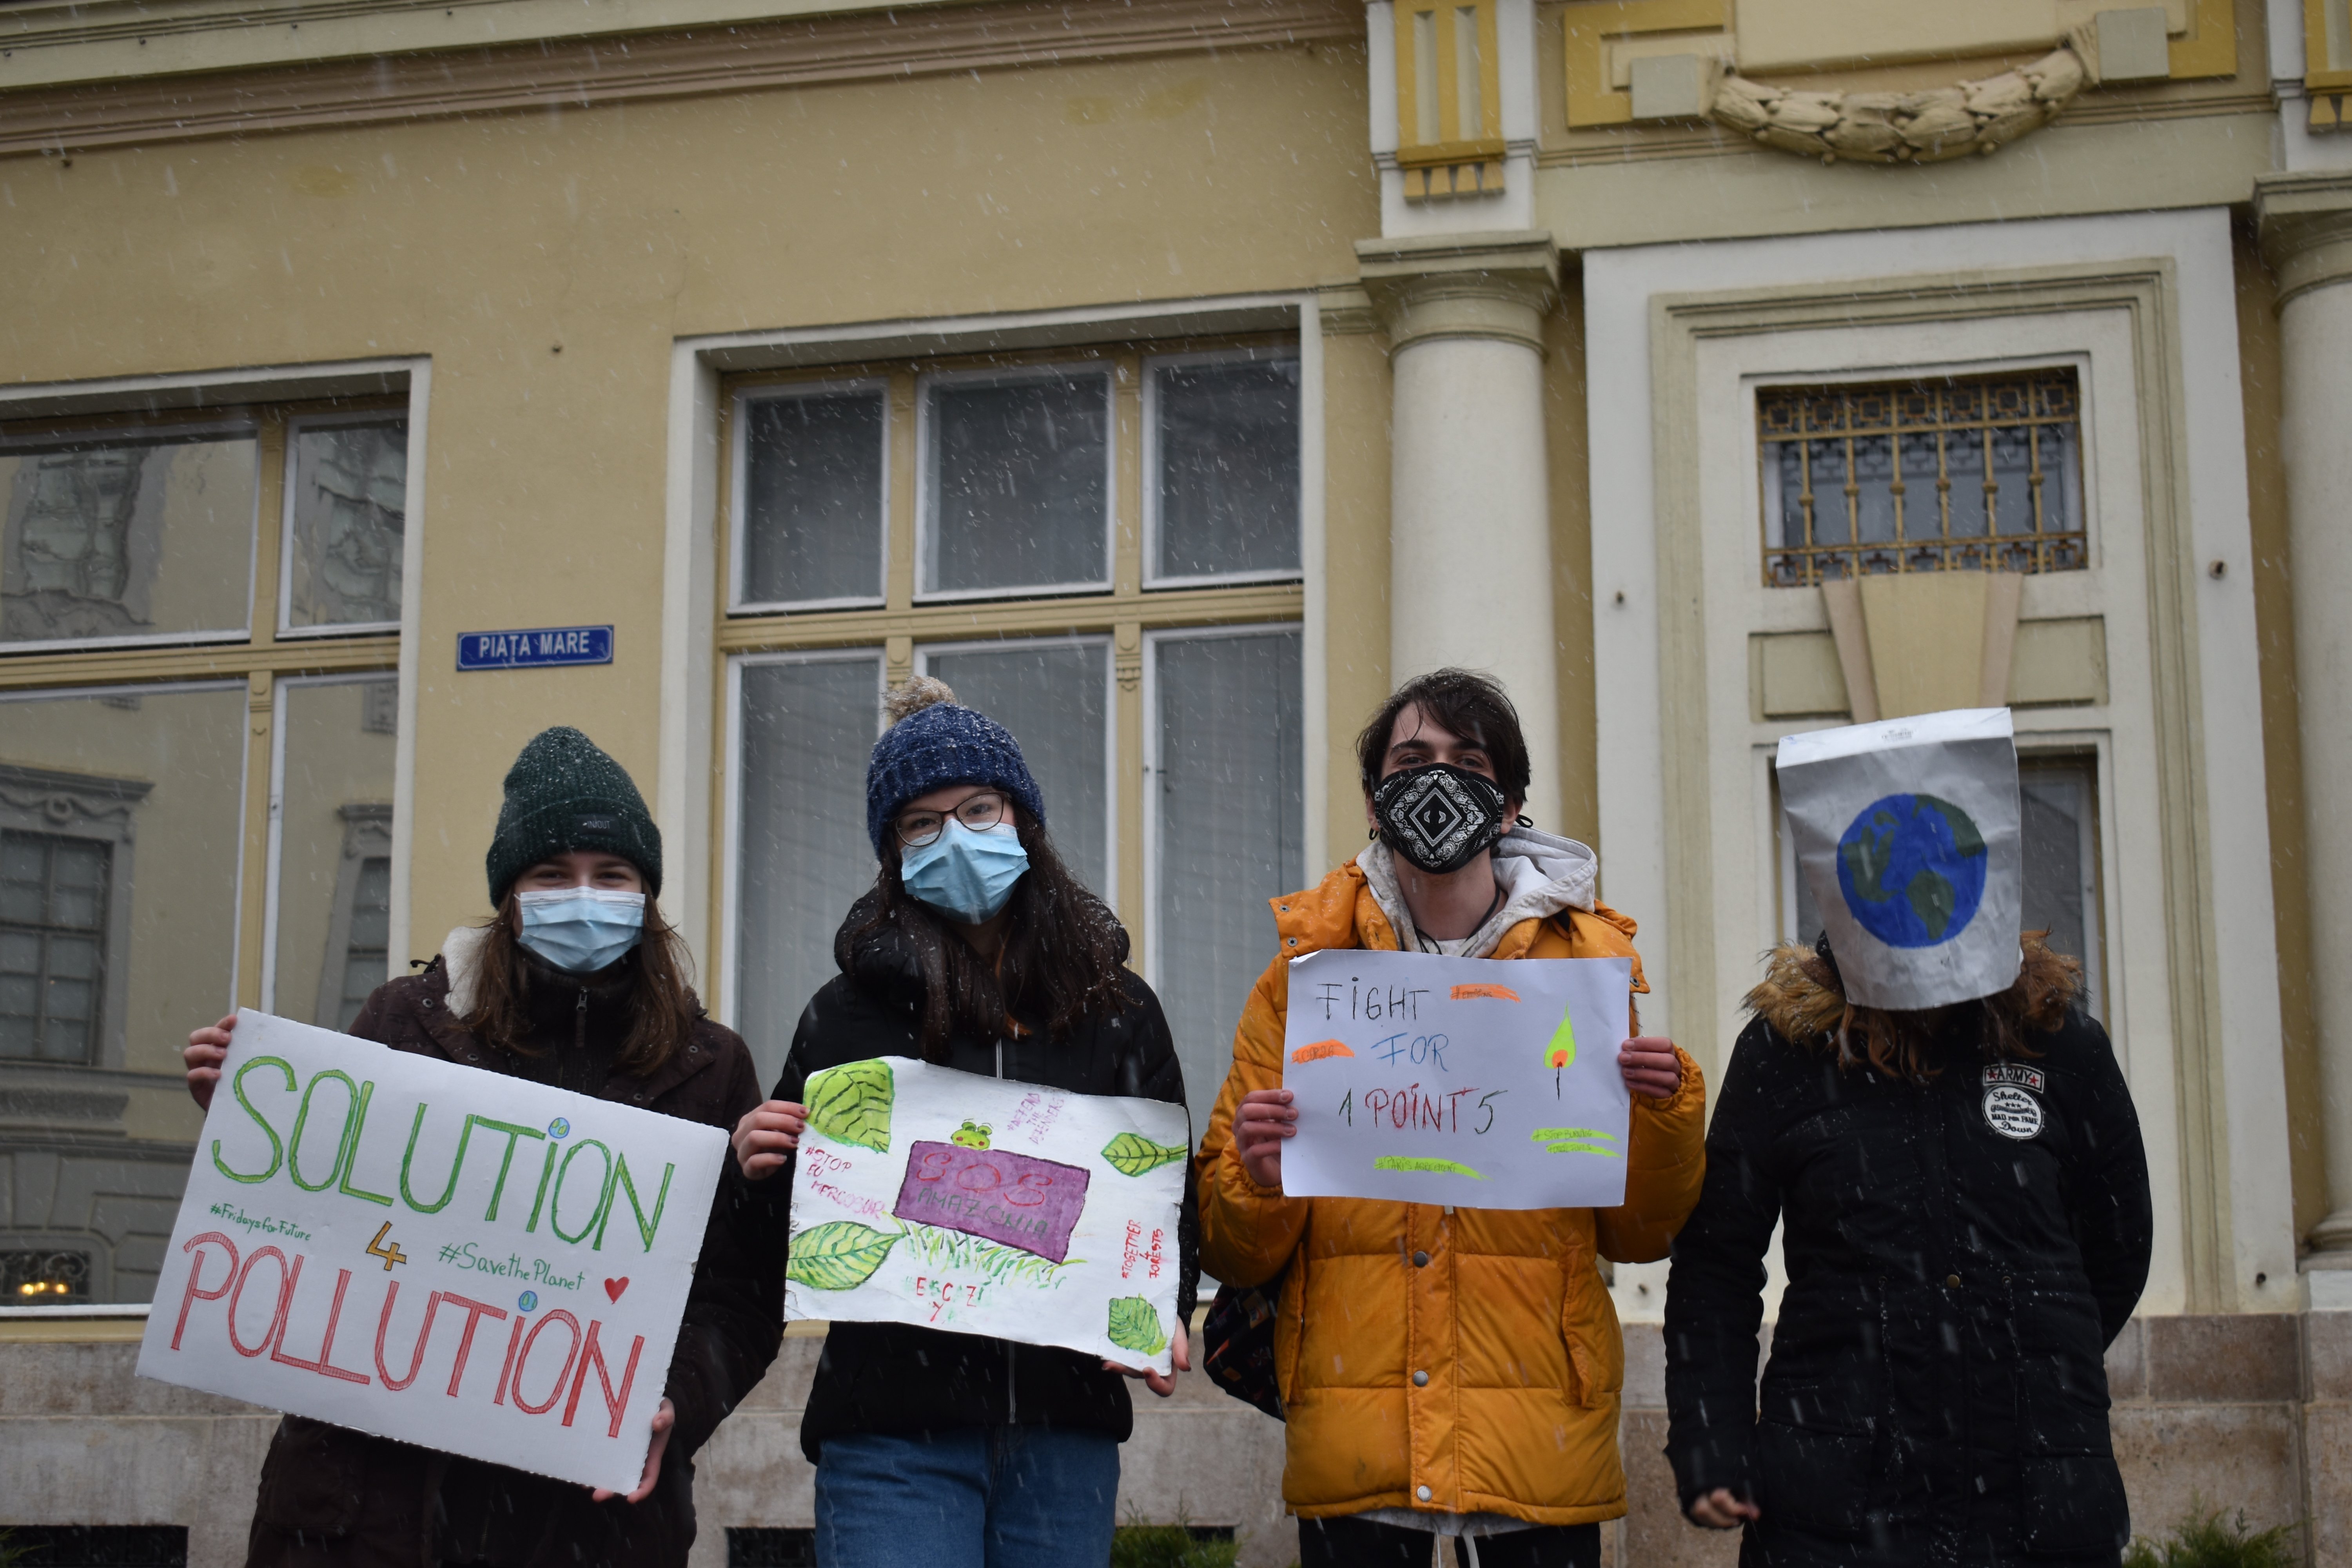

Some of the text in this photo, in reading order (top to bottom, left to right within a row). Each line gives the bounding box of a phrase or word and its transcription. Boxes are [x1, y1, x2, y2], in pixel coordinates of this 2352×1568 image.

[540, 631, 590, 655] MARE
[1316, 976, 1430, 1021] FIGHT
[1371, 1032, 1449, 1072] FOR
[1997, 1067, 2033, 1083] ARMY
[1338, 1083, 1508, 1135] 1 POINT 5
[1993, 1091, 2033, 1105] Shelter
[1998, 1121, 2034, 1133] Down
[2021, 1116, 2039, 1125] FAME
[212, 1055, 675, 1252] SOLUTION
[805, 1146, 852, 1172] #STOP
[916, 1152, 1053, 1207] SOS
[811, 1180, 885, 1220] MERCOSUR
[918, 1187, 1048, 1239] AMAZONIA
[366, 1221, 407, 1272] 4
[1139, 1250, 1152, 1260] 4
[1149, 1228, 1164, 1279] FORESTS
[171, 1231, 645, 1438] POLLUTION
